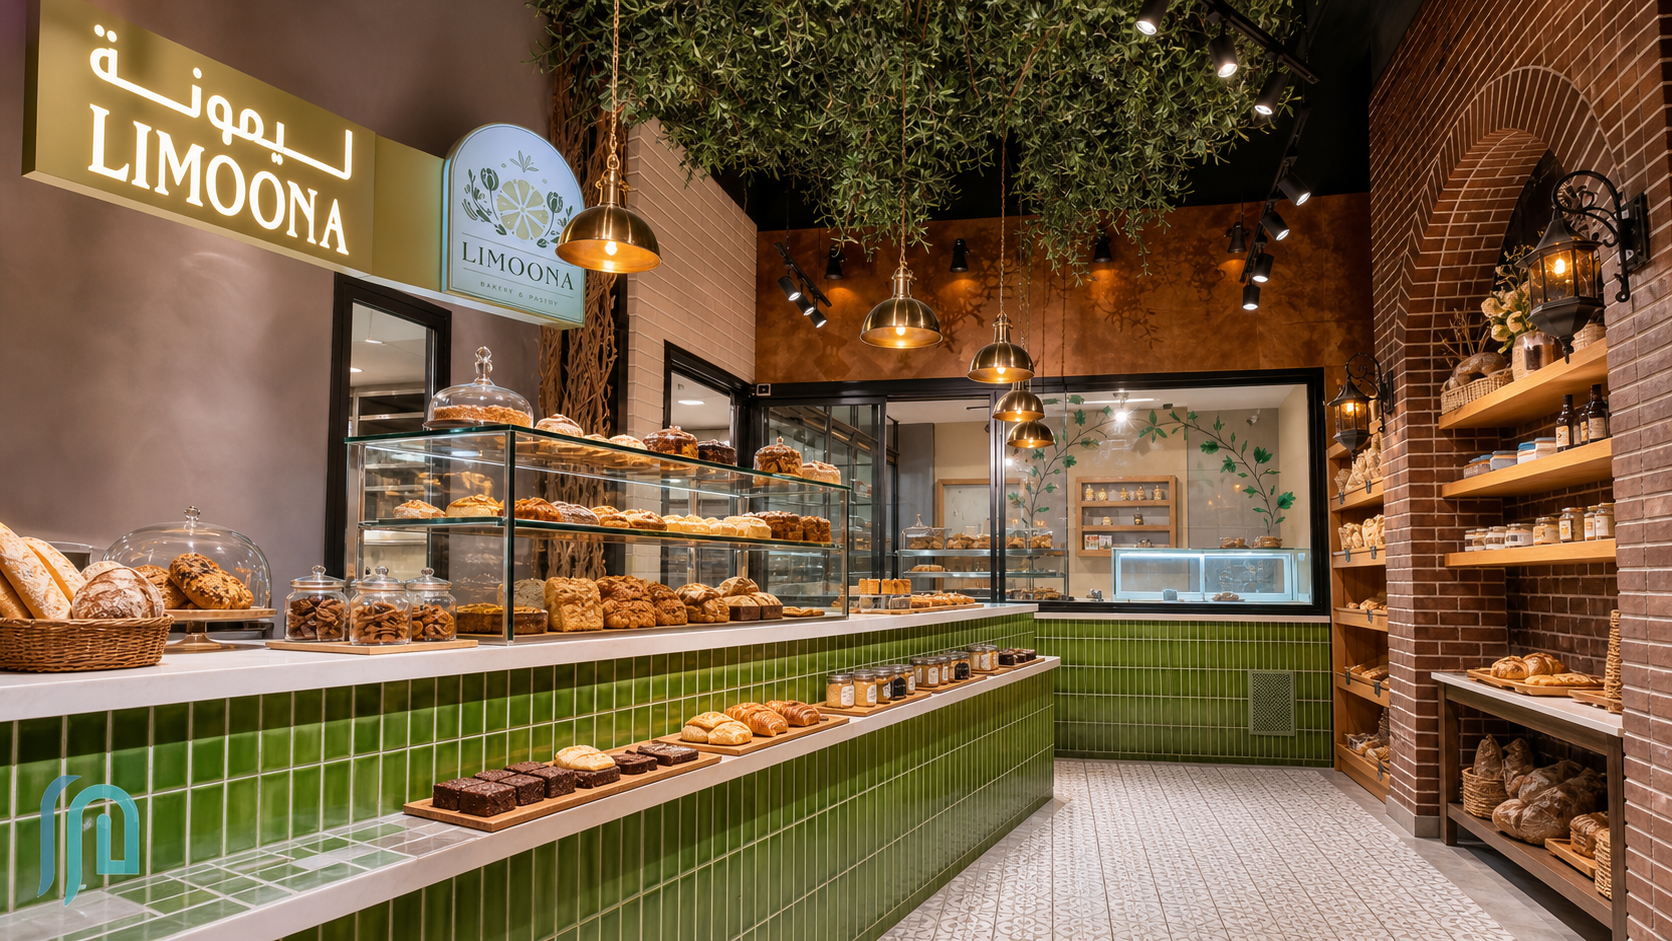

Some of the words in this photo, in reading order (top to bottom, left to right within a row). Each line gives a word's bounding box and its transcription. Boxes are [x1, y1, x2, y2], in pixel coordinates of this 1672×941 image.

[90, 24, 353, 180] ليمونة
[88, 103, 349, 256] LIMOONA
[462, 241, 574, 290] LIMOONA
[480, 281, 513, 295] BAKERY
